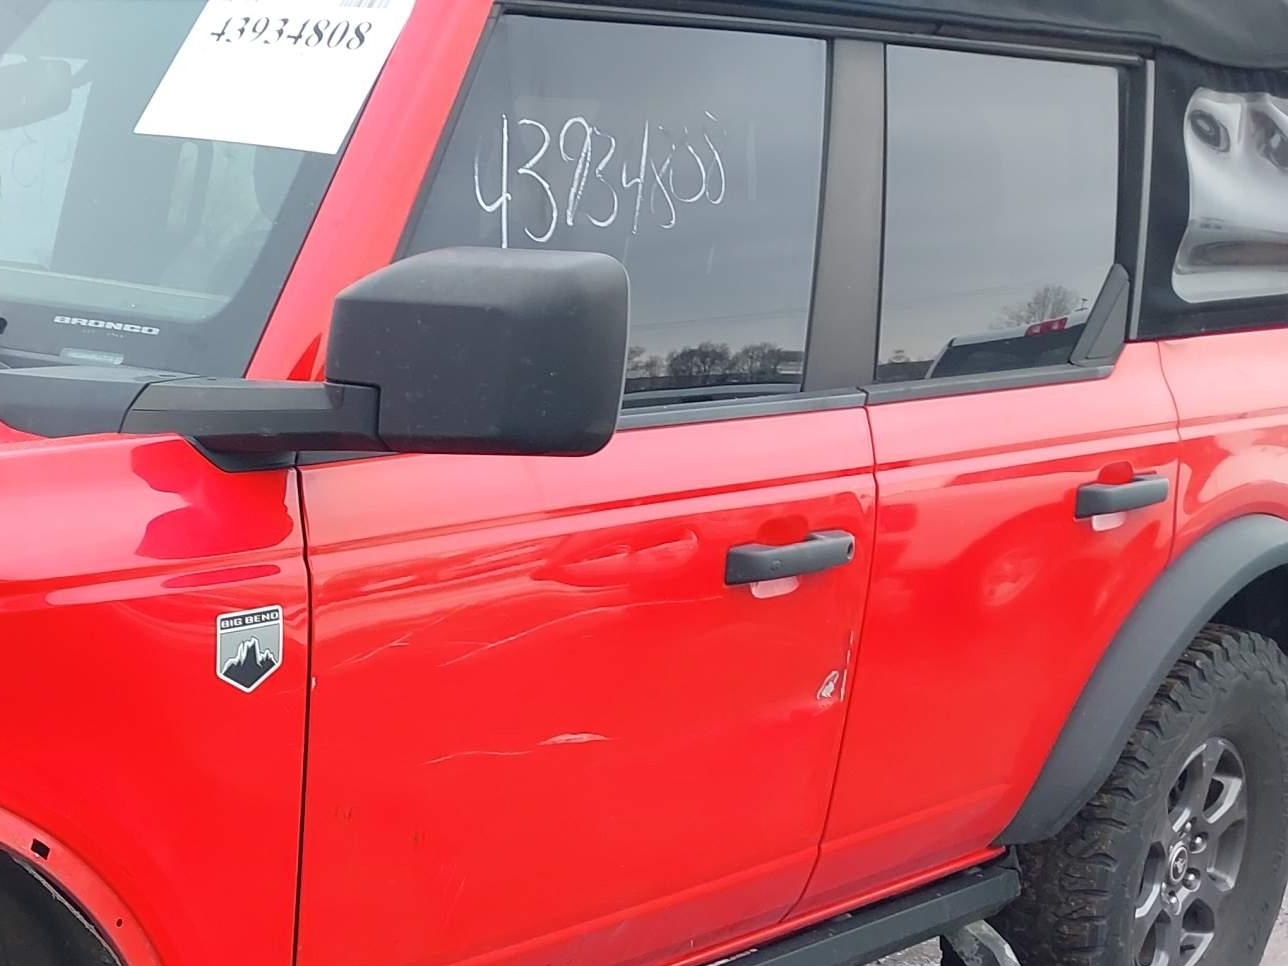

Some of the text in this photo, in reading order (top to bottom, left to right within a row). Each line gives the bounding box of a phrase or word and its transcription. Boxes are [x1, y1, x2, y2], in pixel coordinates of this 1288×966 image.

[210, 16, 372, 50] 43934808
[53, 315, 160, 335] BRONCO
[221, 611, 279, 628] BIG BEND
